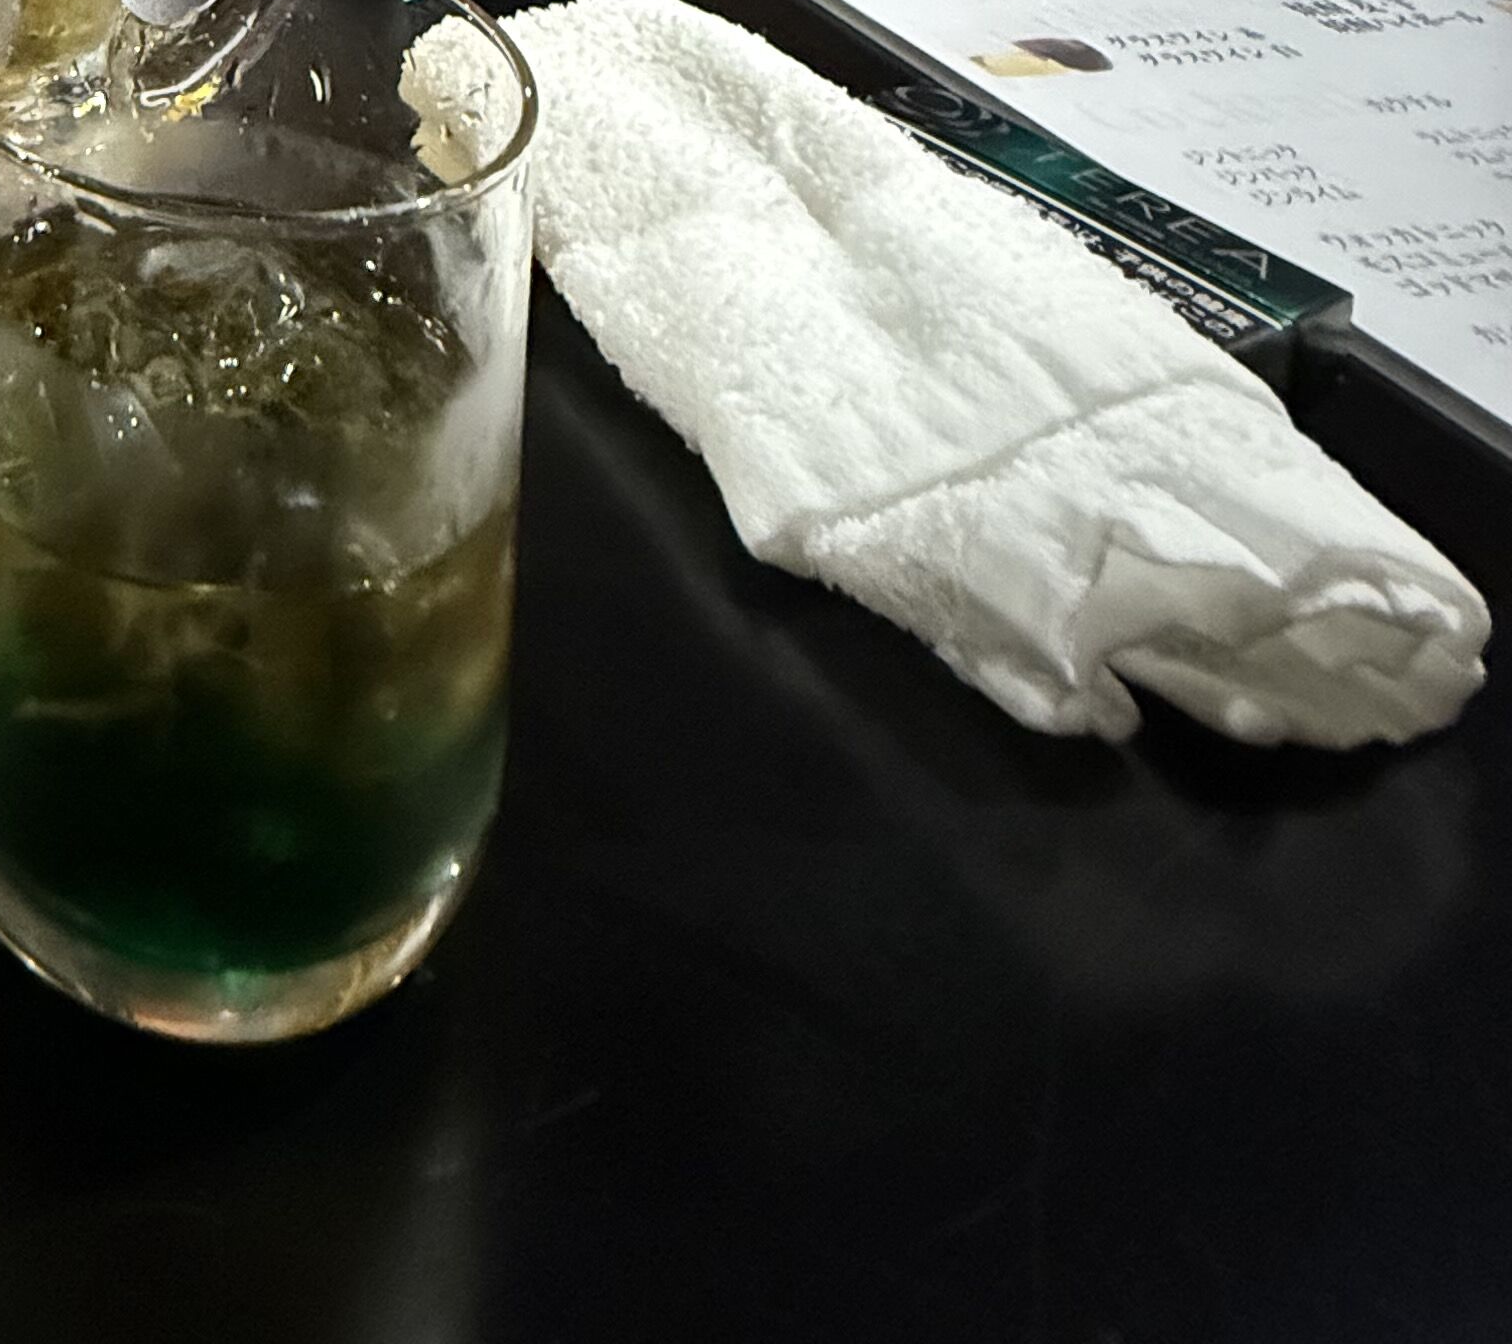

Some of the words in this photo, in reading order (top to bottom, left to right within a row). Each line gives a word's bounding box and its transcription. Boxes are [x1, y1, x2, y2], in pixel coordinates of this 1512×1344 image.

[1415, 124, 1512, 145] ラムトニッ
[1359, 244, 1512, 274] モスコミュー
